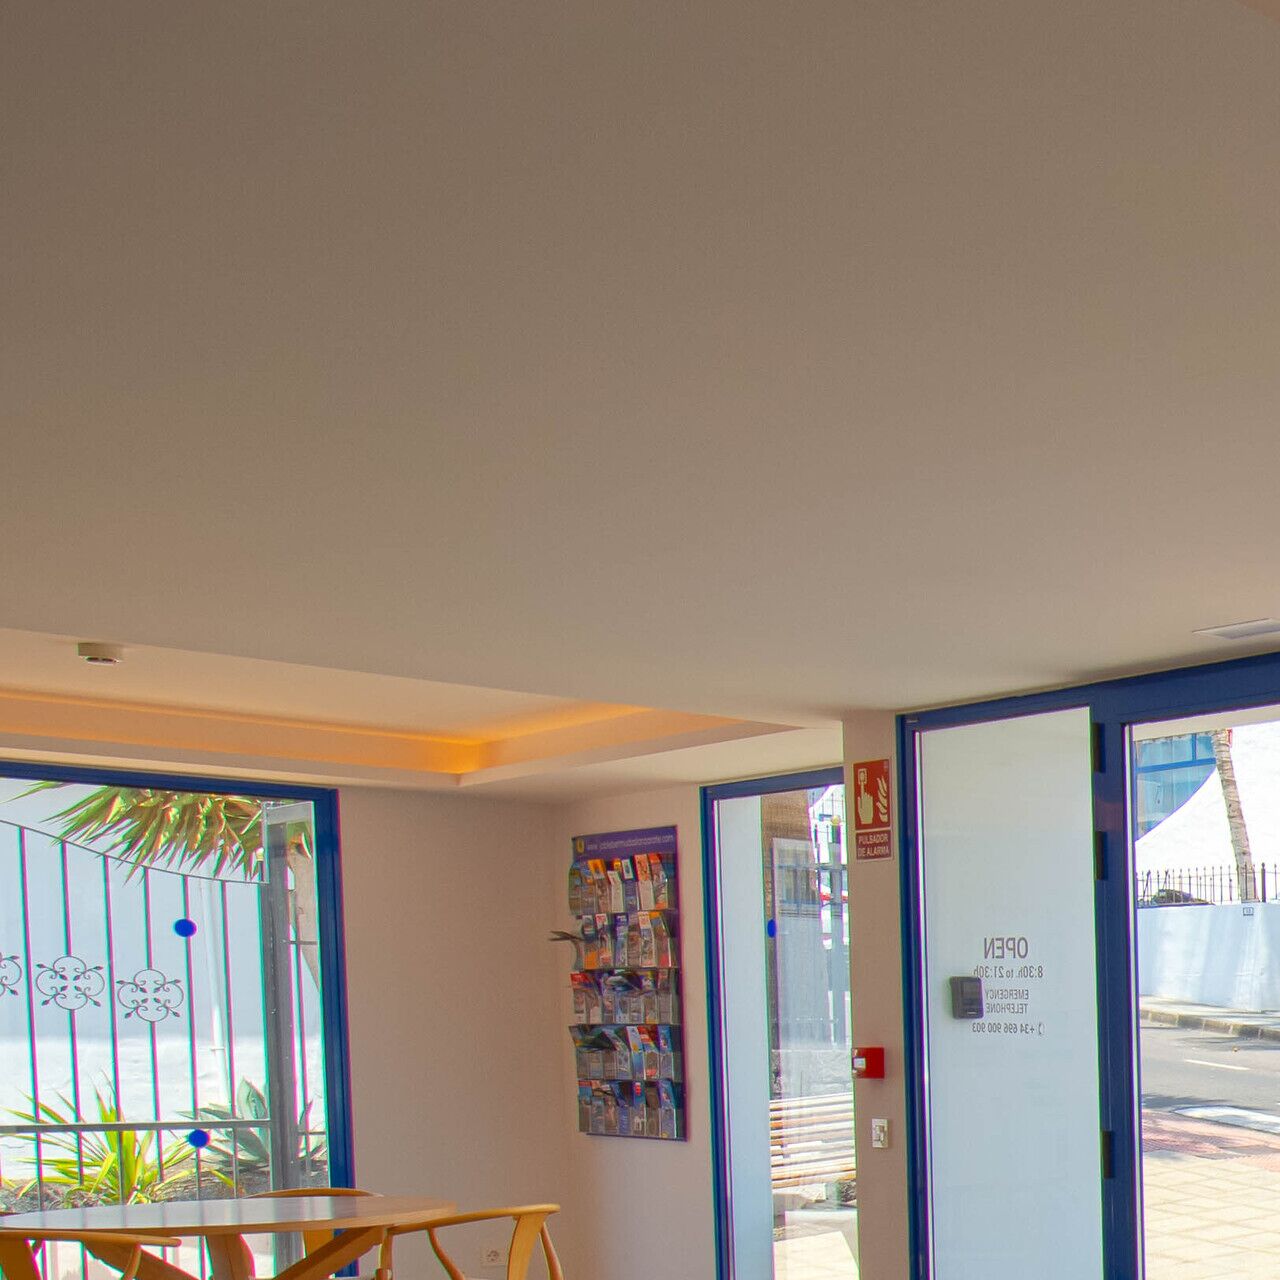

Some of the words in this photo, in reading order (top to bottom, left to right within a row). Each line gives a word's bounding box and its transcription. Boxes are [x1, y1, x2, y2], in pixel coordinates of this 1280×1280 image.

[858, 833, 889, 845] PULSADOR
[858, 847, 866, 857] DE
[866, 845, 890, 856] ALARMA
